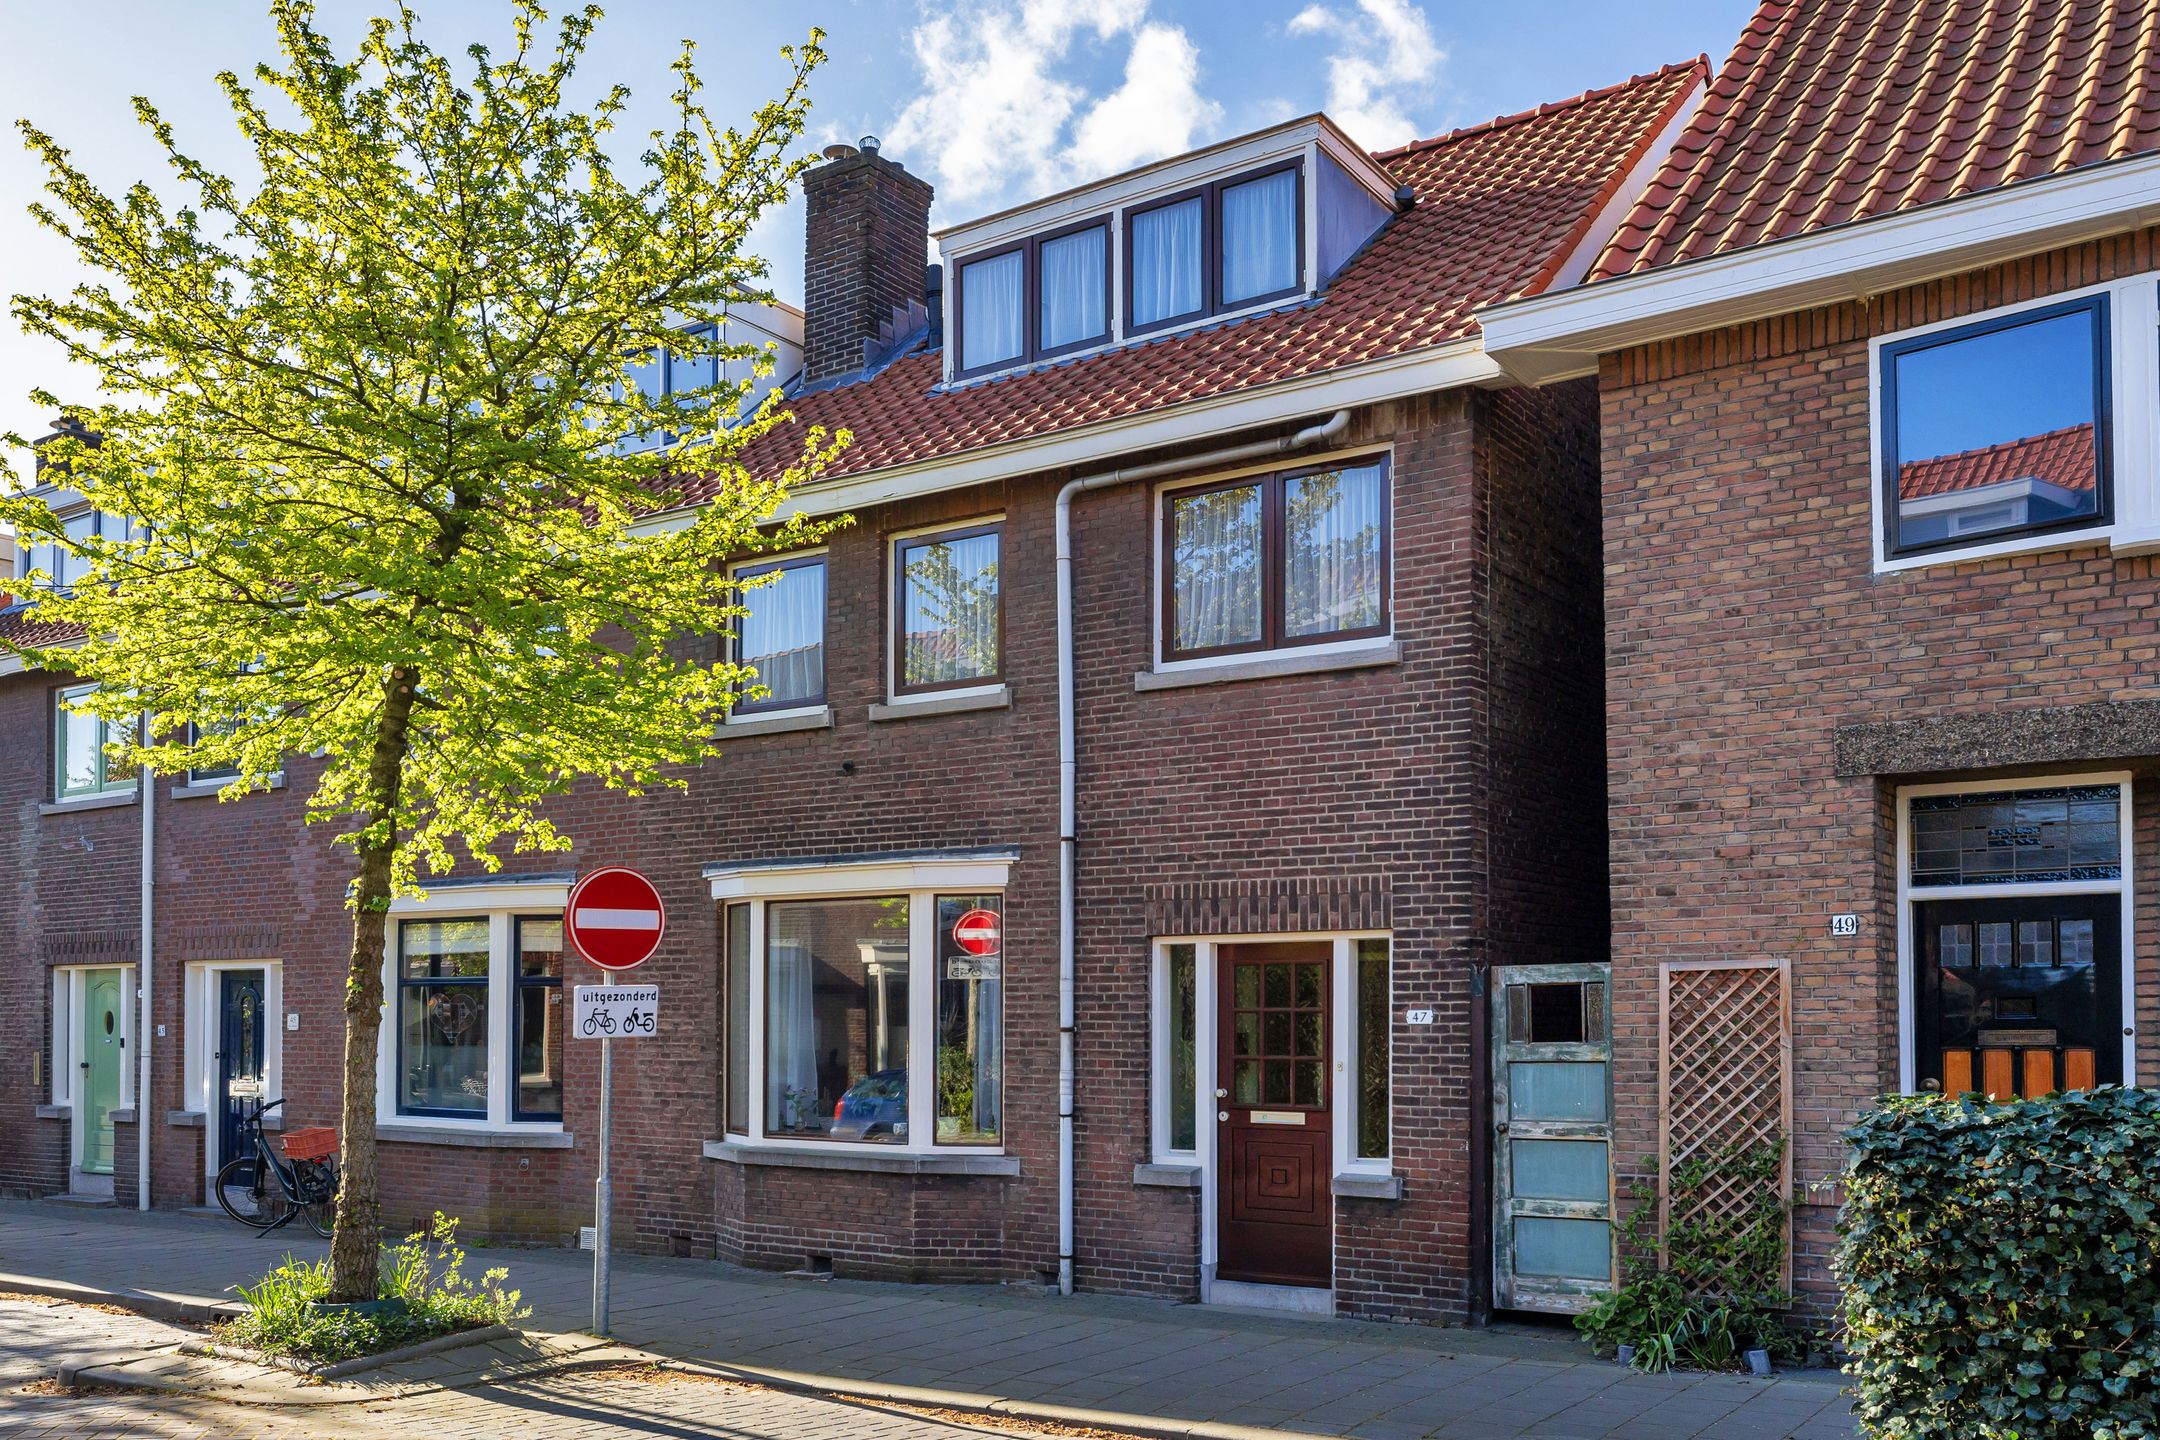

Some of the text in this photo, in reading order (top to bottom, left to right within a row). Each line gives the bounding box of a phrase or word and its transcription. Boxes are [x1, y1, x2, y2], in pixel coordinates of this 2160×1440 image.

[1833, 917, 1855, 932] 49
[582, 990, 657, 1006] uitgezonderd
[1412, 1012, 1427, 1022] 47
